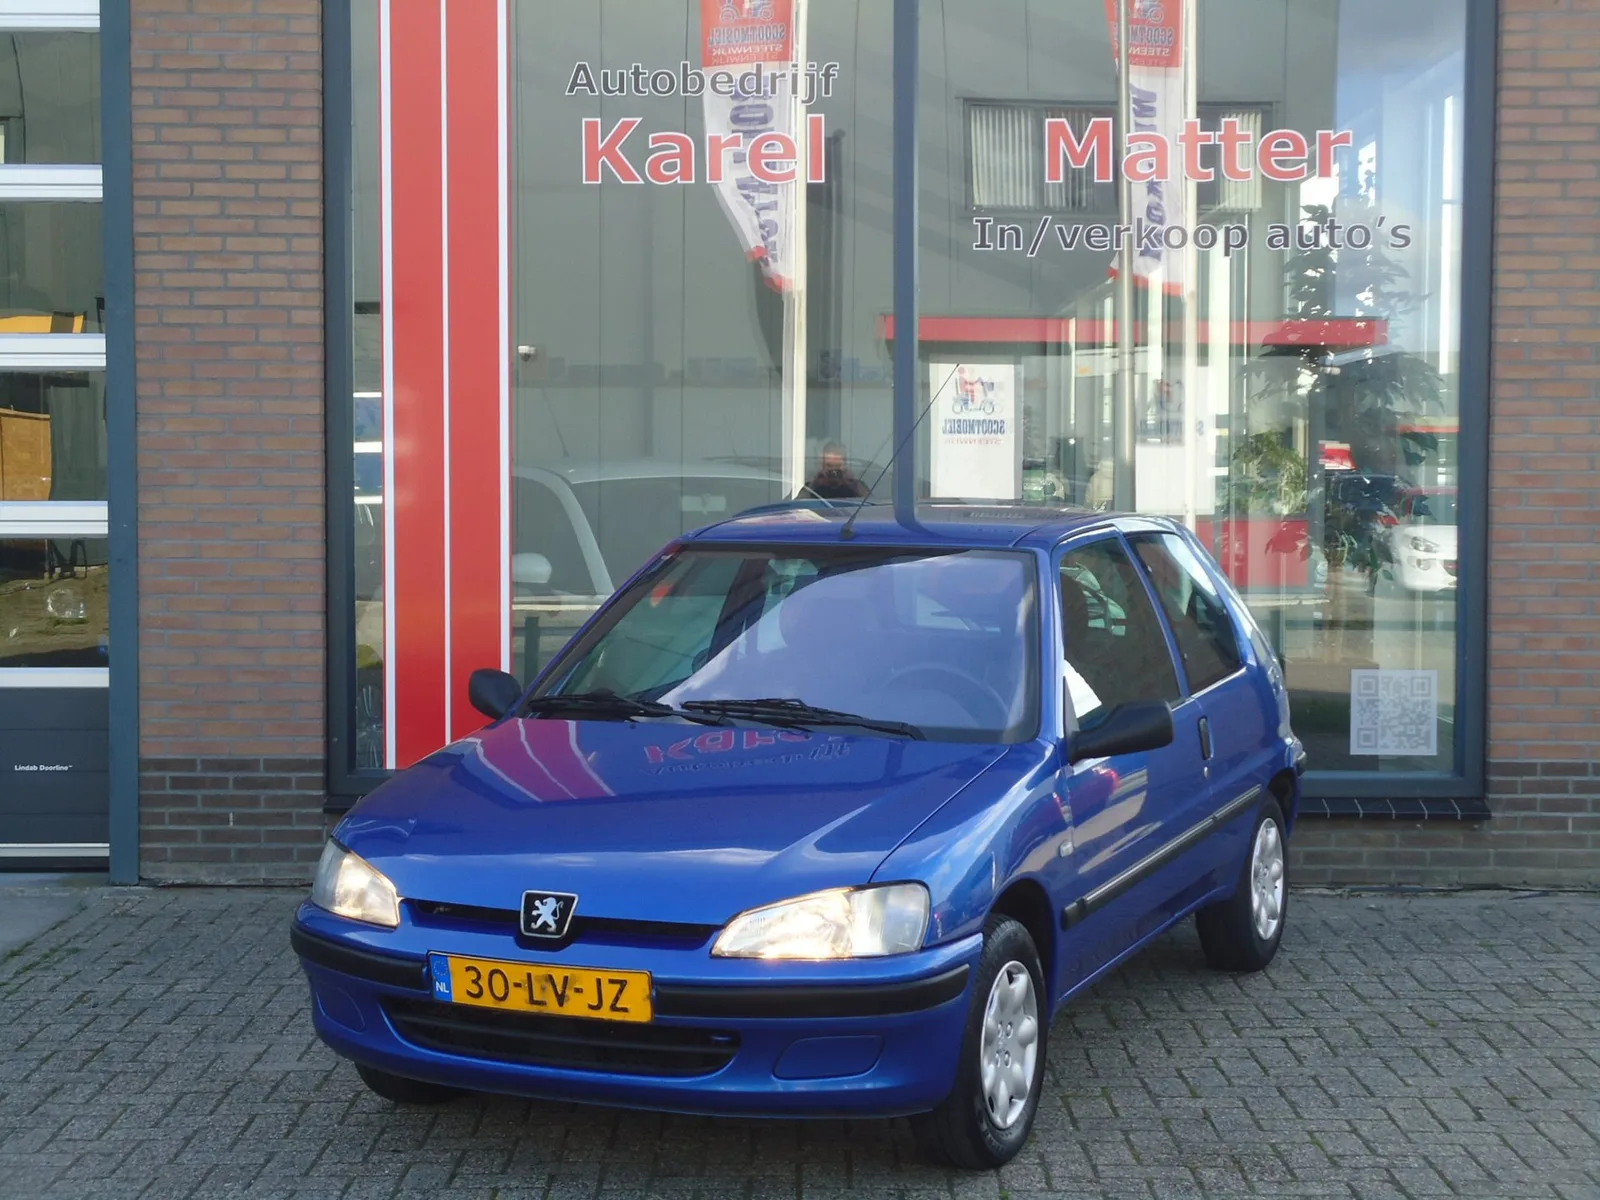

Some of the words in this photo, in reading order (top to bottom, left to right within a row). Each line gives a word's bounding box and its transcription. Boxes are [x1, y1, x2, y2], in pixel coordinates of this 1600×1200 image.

[565, 61, 839, 105] Autobedrijf
[581, 113, 826, 185] Karel
[1044, 117, 1353, 184] Matter
[972, 215, 1249, 258] In/verkoop
[1266, 215, 1412, 251] auto's
[435, 981, 450, 994] NL
[464, 965, 630, 1014] 30-LV-JZ
